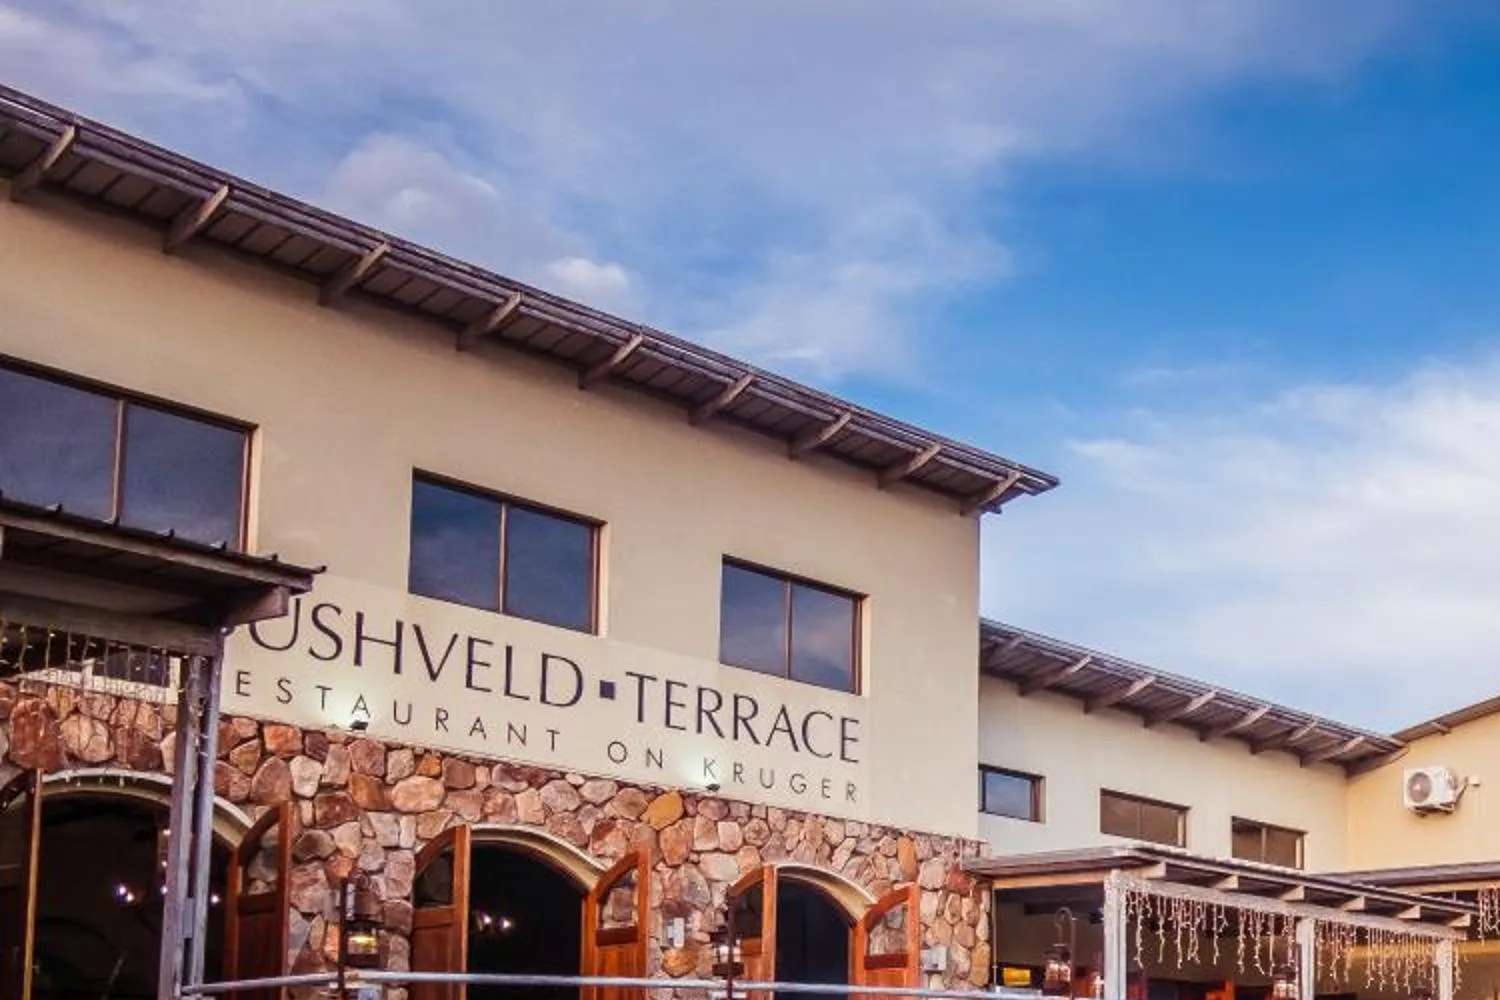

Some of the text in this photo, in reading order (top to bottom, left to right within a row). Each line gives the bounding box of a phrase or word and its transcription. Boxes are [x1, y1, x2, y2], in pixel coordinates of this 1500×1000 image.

[235, 669, 857, 802] ESTAURANT ON KRUGER
[249, 597, 860, 764] USHVELD TERRACE
